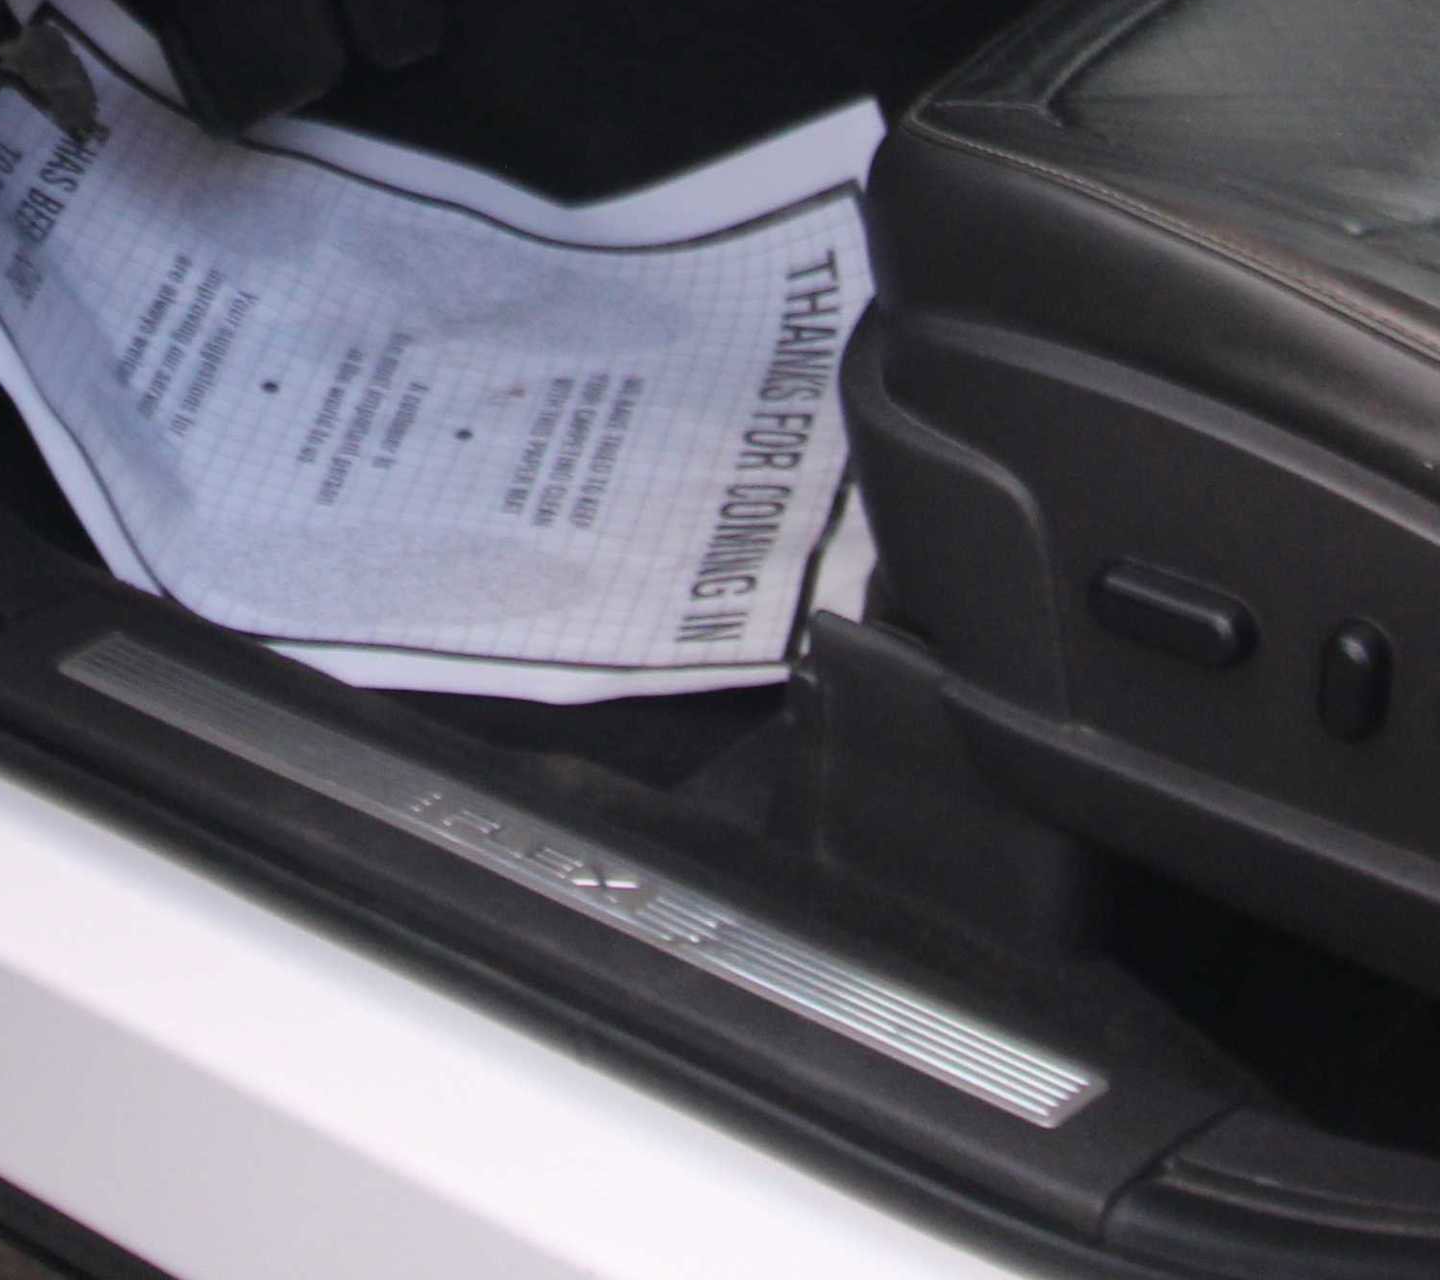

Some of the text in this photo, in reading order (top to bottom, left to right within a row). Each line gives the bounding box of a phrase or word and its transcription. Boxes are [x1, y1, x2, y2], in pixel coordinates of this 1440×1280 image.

[674, 249, 840, 644] THANKS FOR COMING IN
